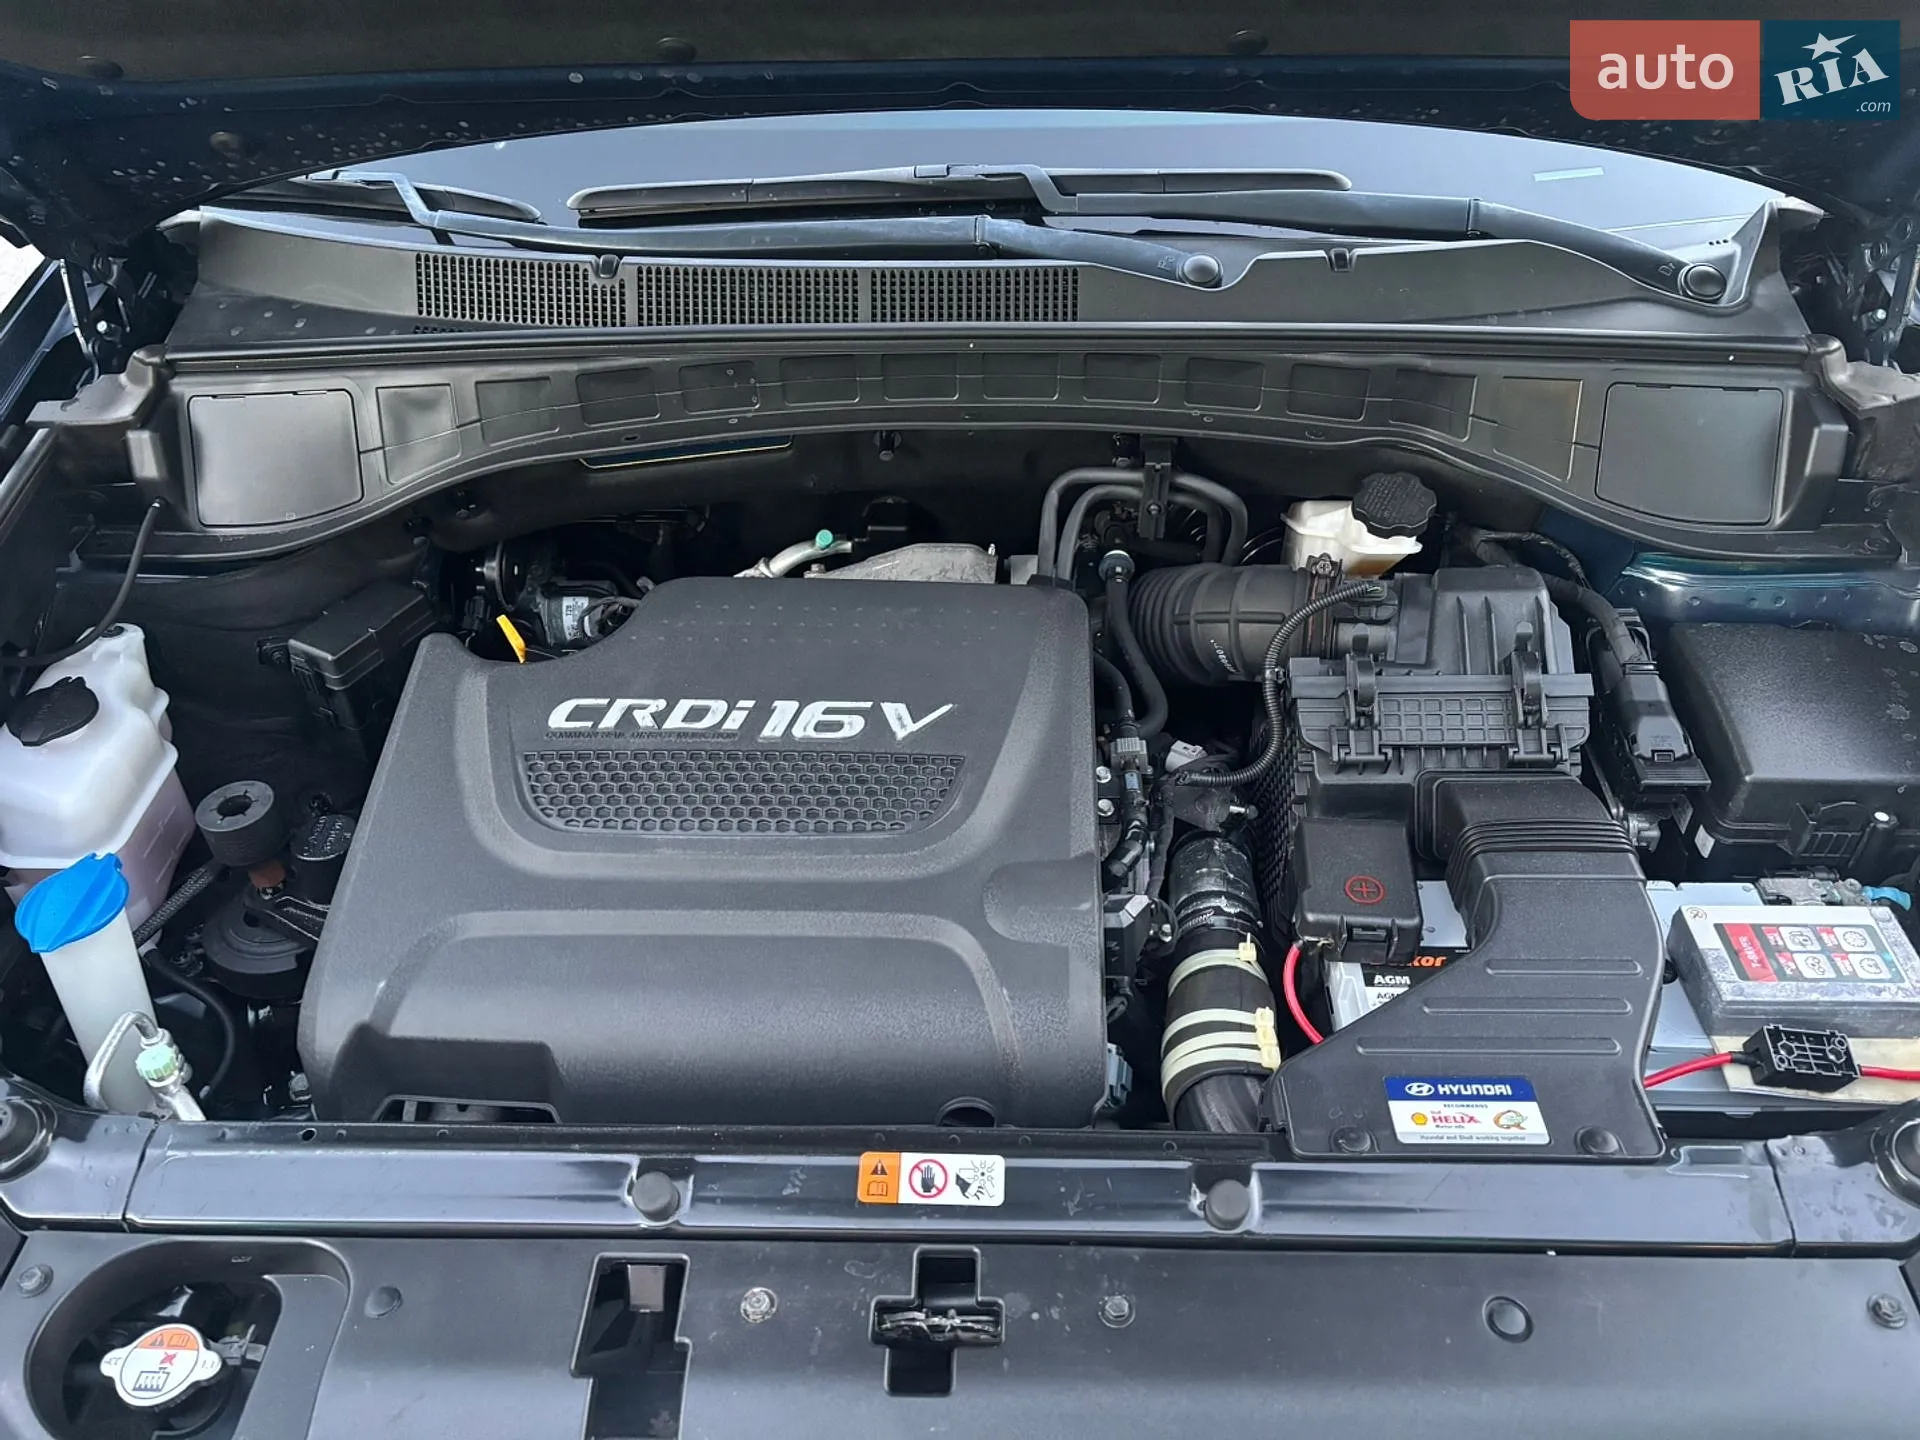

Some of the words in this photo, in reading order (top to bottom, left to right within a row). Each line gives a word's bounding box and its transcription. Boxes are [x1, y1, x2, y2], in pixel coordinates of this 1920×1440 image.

[547, 698, 756, 731] CRDi
[1373, 974, 1411, 985] AGM
[1438, 1084, 1512, 1096] HYUNDAI
[1431, 1115, 1481, 1124] HELIX
